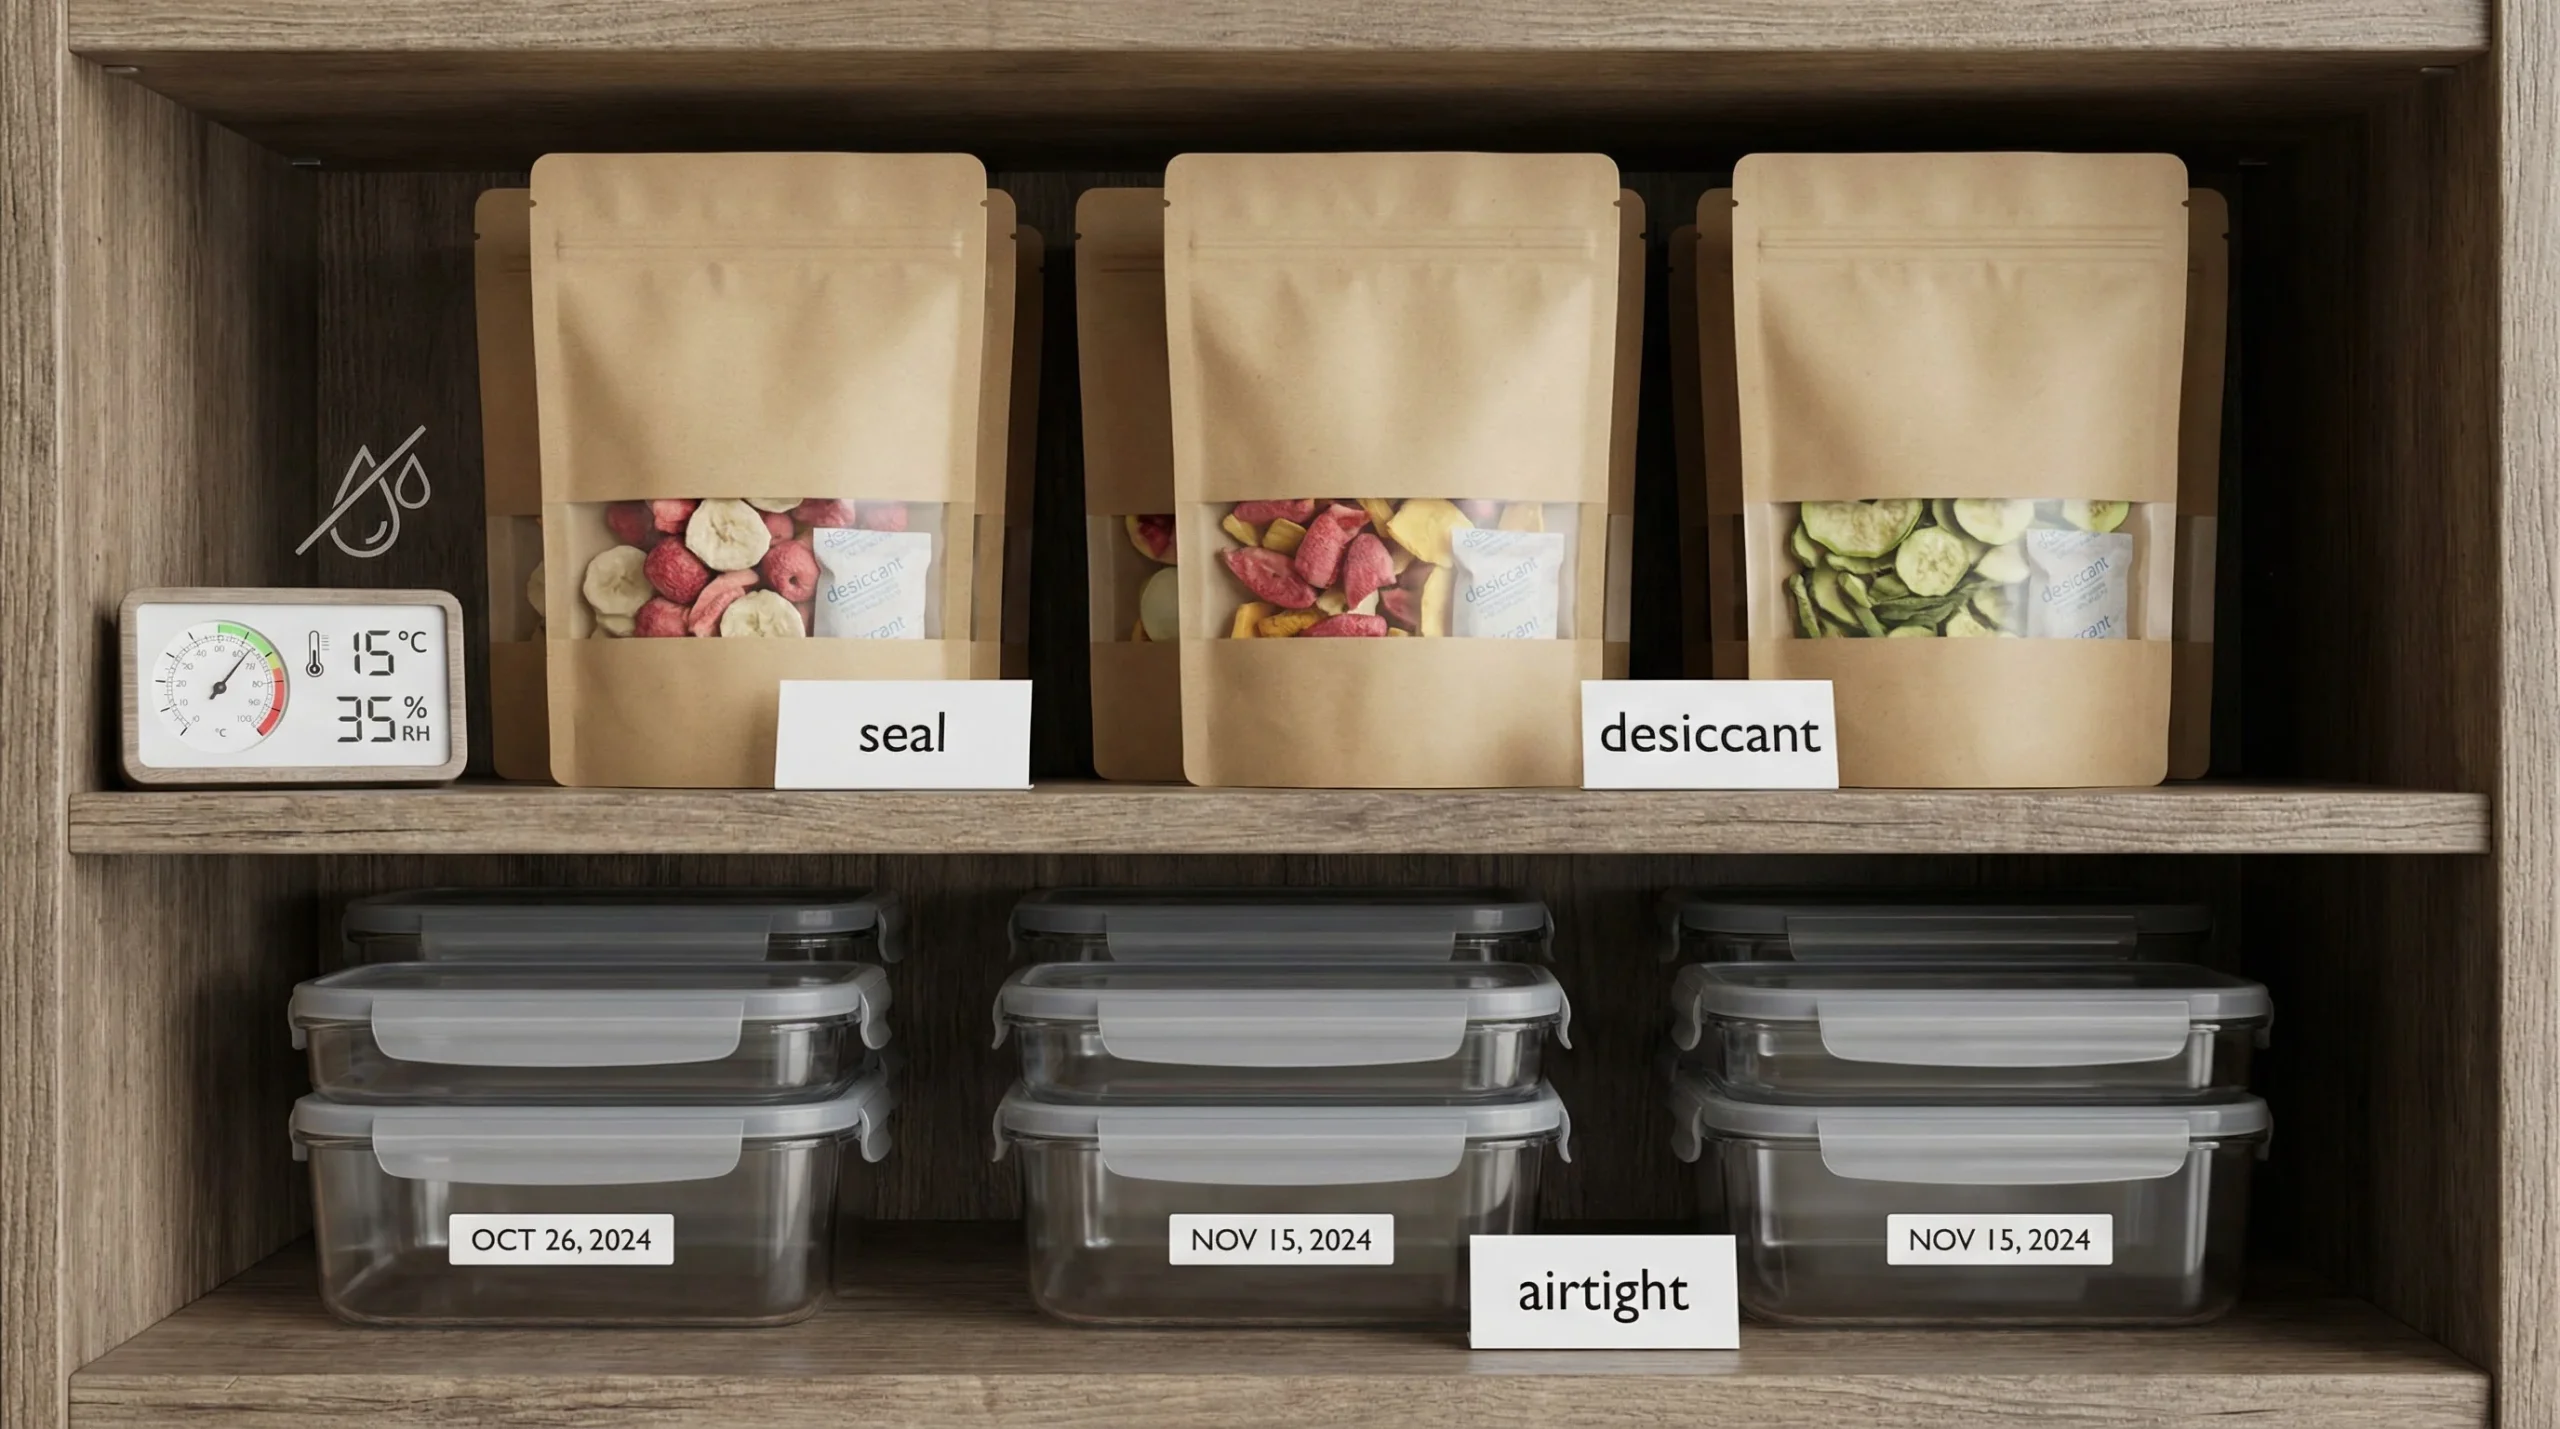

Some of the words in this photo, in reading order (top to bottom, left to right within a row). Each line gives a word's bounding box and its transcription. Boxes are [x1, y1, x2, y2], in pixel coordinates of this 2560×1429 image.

[826, 557, 904, 603] desiccant
[1465, 557, 1539, 603] desiccant
[2041, 557, 2110, 603] desiccant
[402, 725, 430, 742] RH
[859, 711, 945, 753] seal
[1600, 711, 1822, 753] desiccant
[471, 1228, 537, 1251] OCT
[545, 1228, 583, 1254] 26,
[589, 1228, 652, 1252] 2024
[1192, 1228, 1258, 1251] NOV
[1271, 1228, 1303, 1254] 15,
[1309, 1228, 1372, 1252] 2024
[1910, 1228, 1976, 1251] NOV
[1989, 1228, 2021, 1255] 15,
[2028, 1228, 2091, 1252] 2024
[1519, 1268, 1690, 1324] airtight
